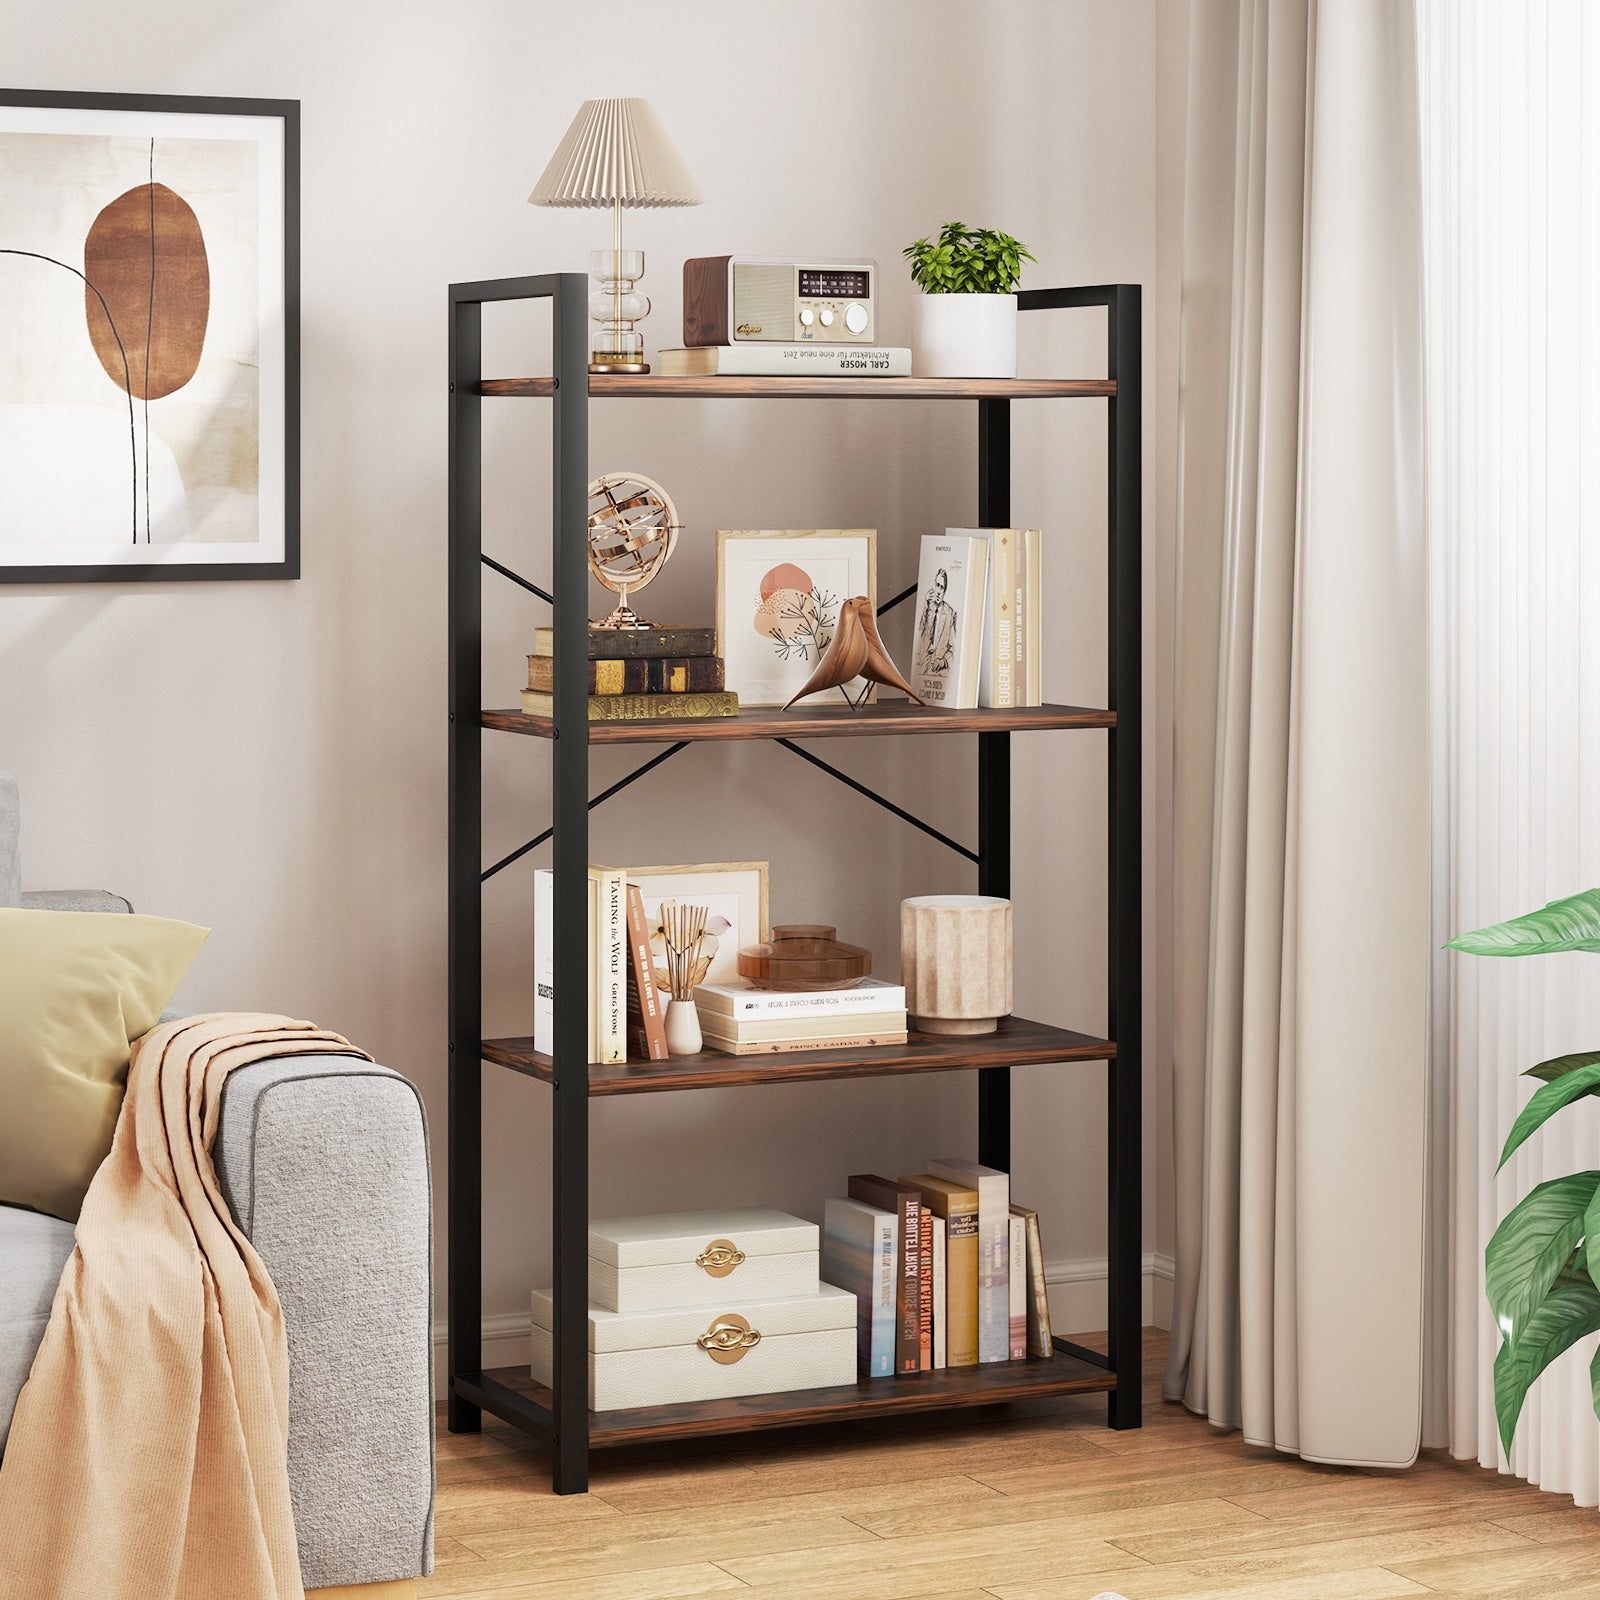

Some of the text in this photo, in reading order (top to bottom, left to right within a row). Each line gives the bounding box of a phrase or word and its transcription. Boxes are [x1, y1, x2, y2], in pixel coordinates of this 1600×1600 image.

[783, 350, 798, 358] Zeit
[836, 351, 848, 360] für
[849, 351, 890, 360] Architektur
[840, 360, 890, 369] CARL MOSER
[1015, 615, 1022, 627] WE
[999, 620, 1010, 705] EUGENE ONEGIN
[611, 877, 620, 1036] TAMING the WOLF GREG STONE
[638, 944, 655, 1017] WHY DO WE LOVE CATS
